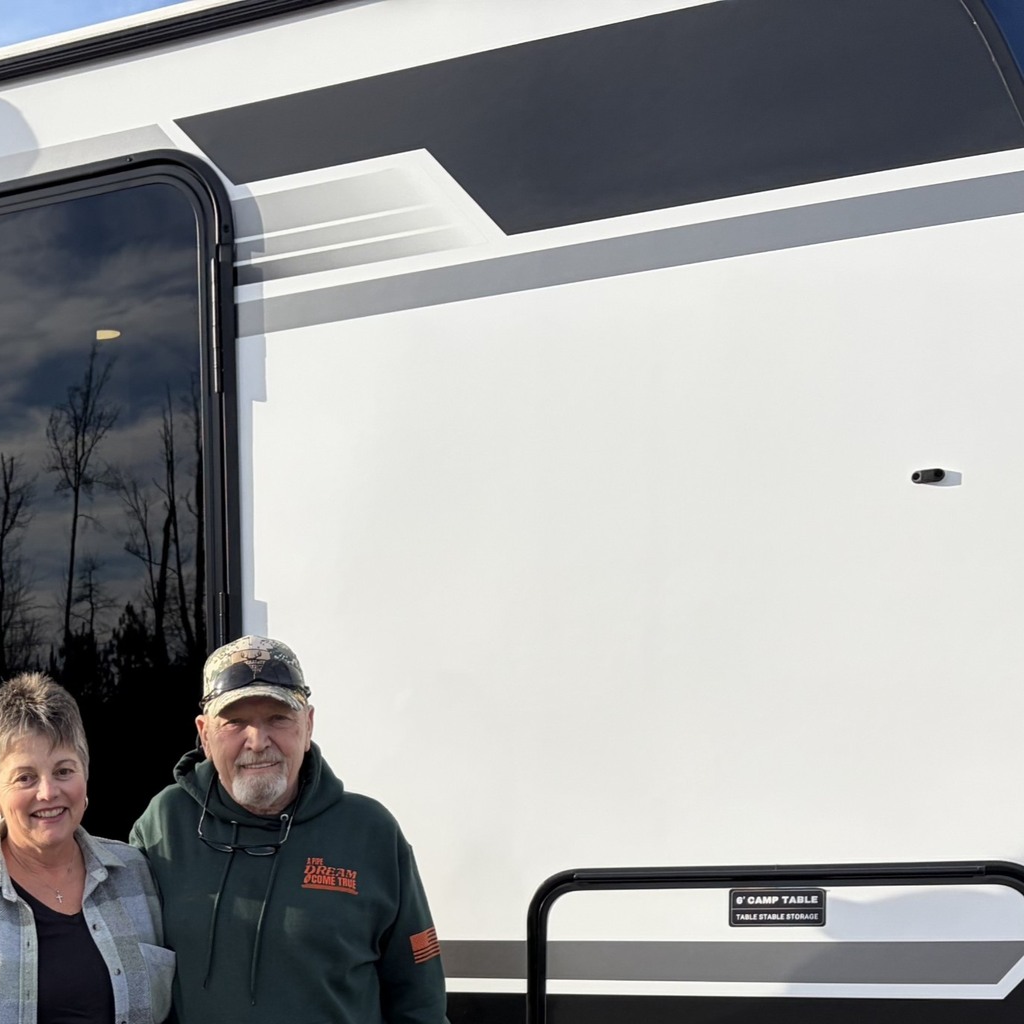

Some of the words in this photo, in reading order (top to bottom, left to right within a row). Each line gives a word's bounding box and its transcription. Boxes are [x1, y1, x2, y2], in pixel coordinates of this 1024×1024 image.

[303, 865, 358, 879] DREAM
[311, 874, 336, 886] COME
[337, 877, 357, 889] TRUE
[747, 896, 779, 904] CAMP
[781, 895, 819, 904] TABLE
[786, 912, 819, 920] STORAGE
